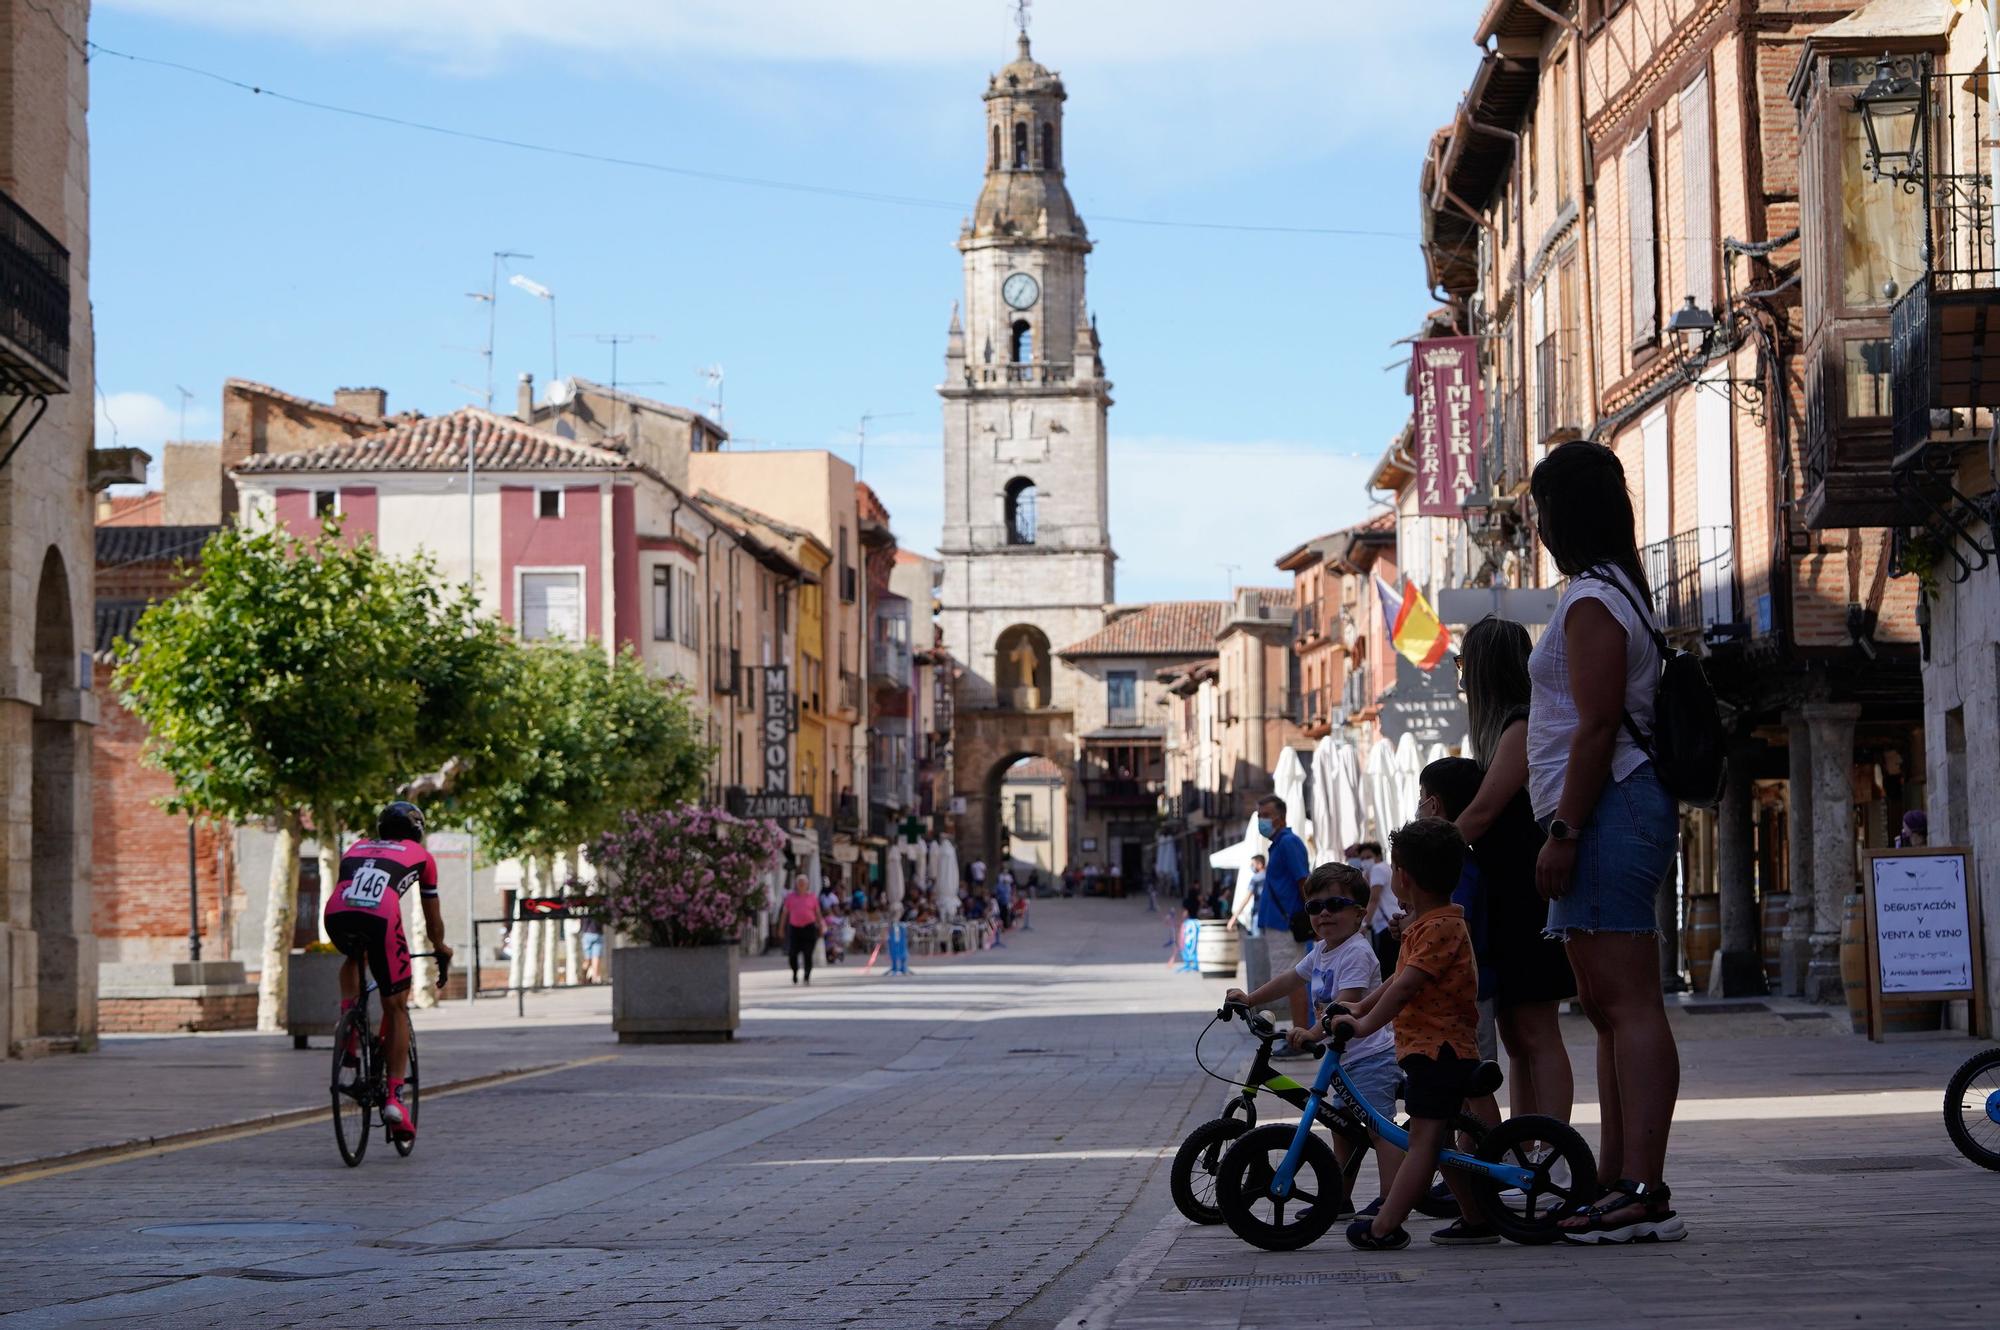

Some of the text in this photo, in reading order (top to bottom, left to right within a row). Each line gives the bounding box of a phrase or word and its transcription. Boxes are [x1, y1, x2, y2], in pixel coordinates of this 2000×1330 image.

[765, 669, 787, 792] MESON
[744, 796, 809, 817] ZAMORA
[354, 871, 386, 899] 146
[1883, 899, 1956, 913] DEGUSTACIÓN
[1917, 916, 1924, 925] Y
[1881, 929, 1962, 940] VENTA DE VINO
[1331, 1076, 1367, 1120] SAWYER
